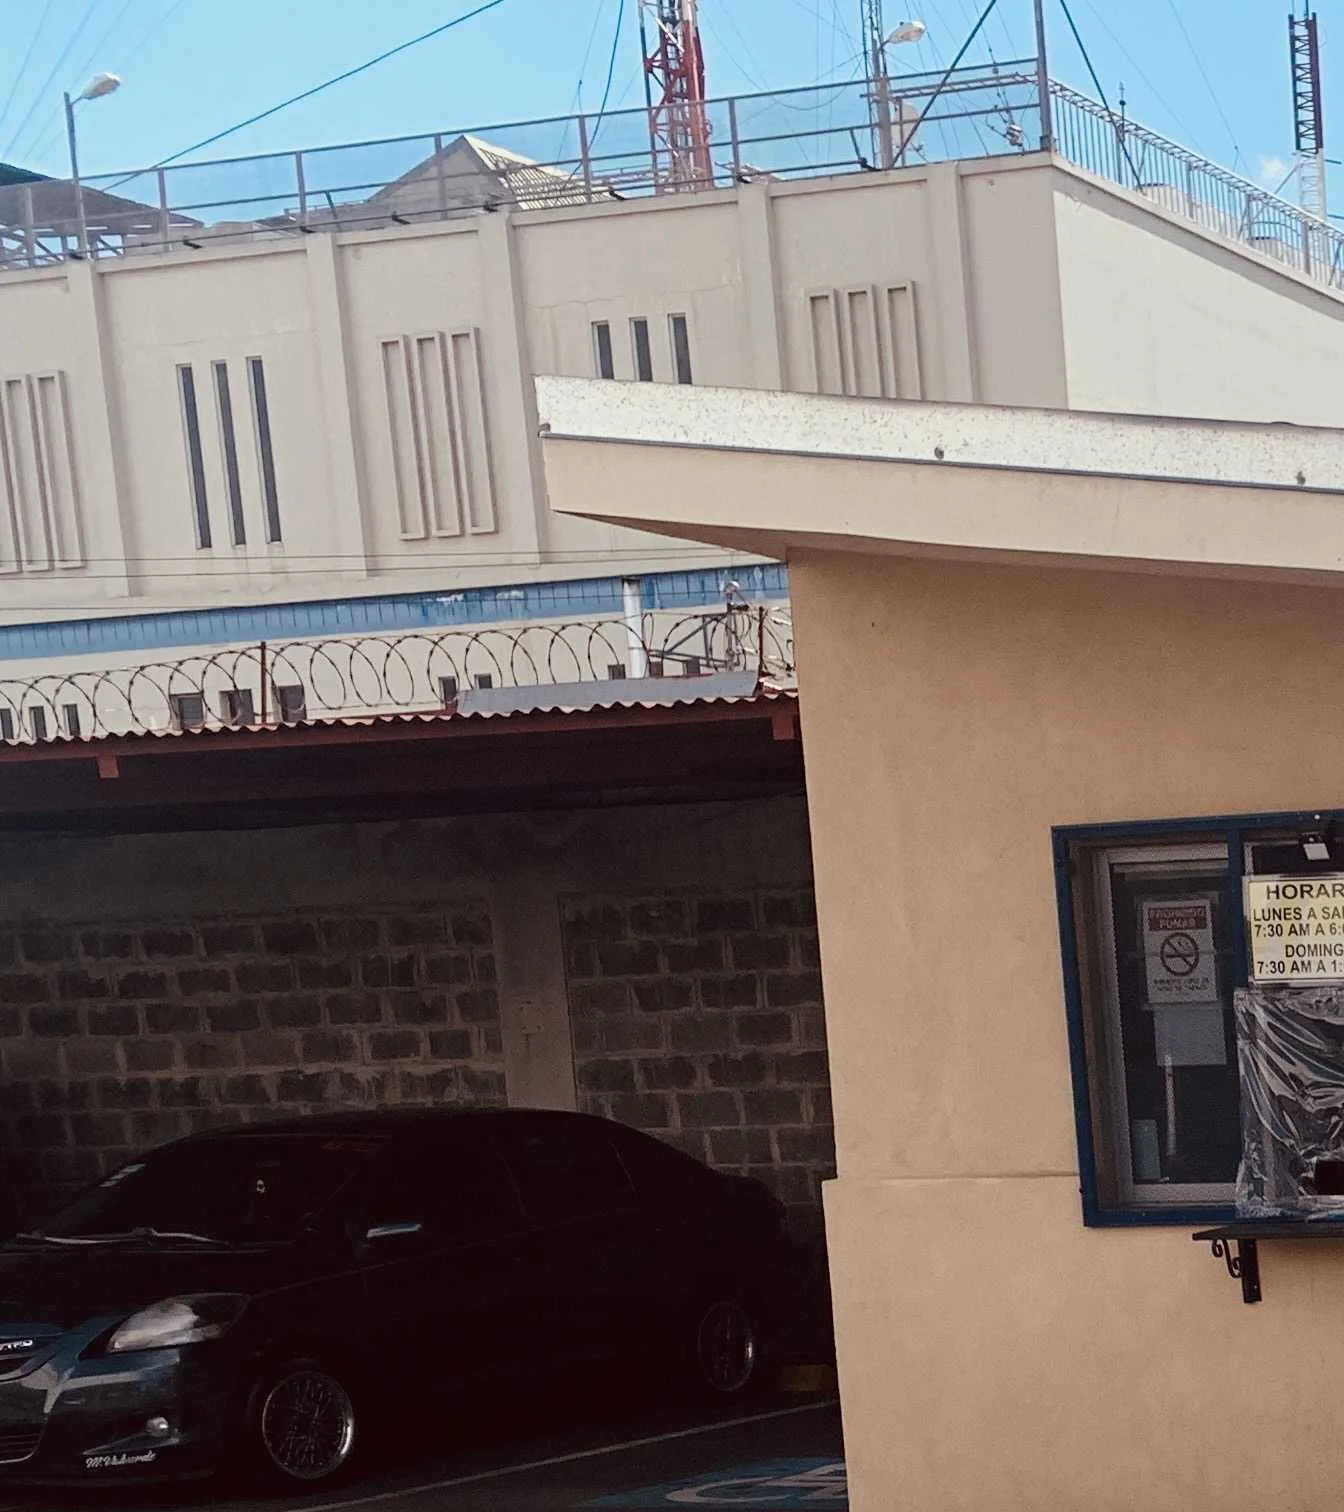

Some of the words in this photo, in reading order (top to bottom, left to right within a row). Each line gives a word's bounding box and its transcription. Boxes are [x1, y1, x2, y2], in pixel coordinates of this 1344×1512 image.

[1254, 907, 1302, 921] LUNES
[1307, 907, 1317, 920] A
[1254, 924, 1283, 938] 7:30
[1288, 923, 1310, 936] AM
[1315, 923, 1325, 936] A
[1257, 961, 1285, 974] 7:30
[1290, 960, 1312, 973] AM
[1316, 960, 1326, 972] A
